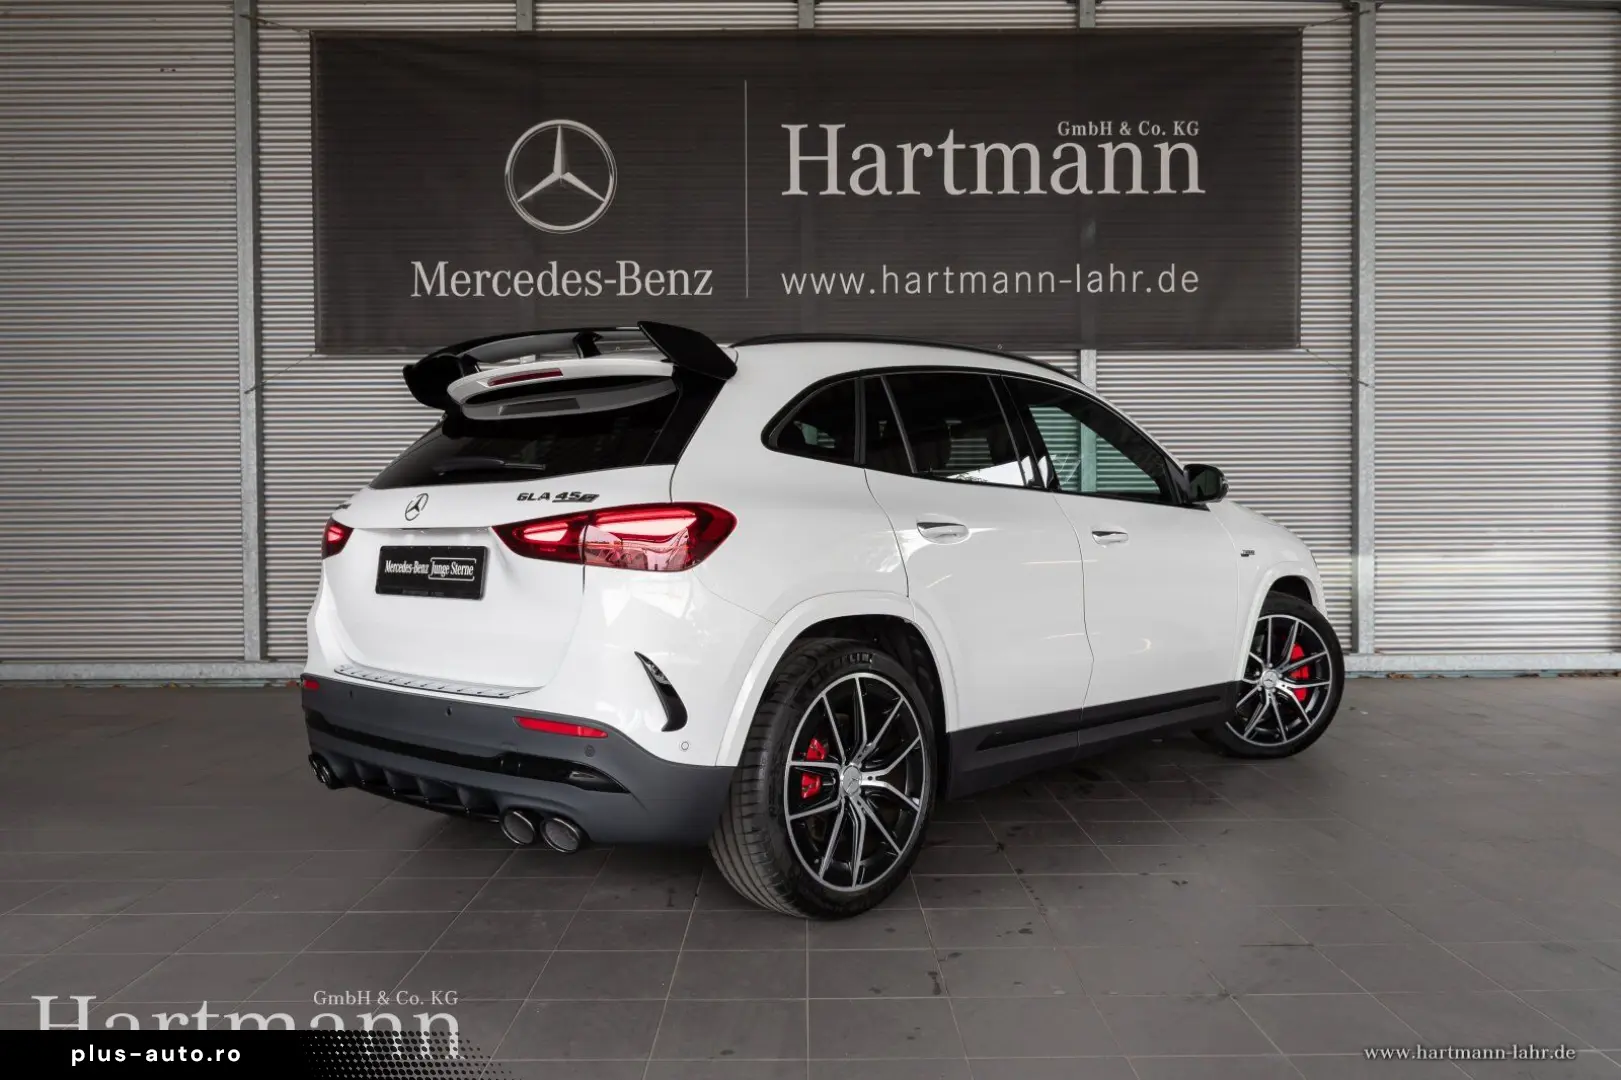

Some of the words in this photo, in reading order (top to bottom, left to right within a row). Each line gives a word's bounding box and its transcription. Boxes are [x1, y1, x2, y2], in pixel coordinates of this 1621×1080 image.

[1057, 121, 1112, 137] GmbH
[1119, 121, 1132, 137] &
[1138, 120, 1166, 136] Co.
[1173, 120, 1200, 136] KG
[781, 123, 1206, 196] Hartmann
[410, 260, 713, 297] Mercedes-Benz
[781, 262, 1200, 295] www.hartmann-lahr.de
[517, 492, 551, 502] GLA
[384, 560, 430, 575] Mercedes-Benz
[430, 561, 450, 577] Junge
[450, 561, 474, 575] Sterne
